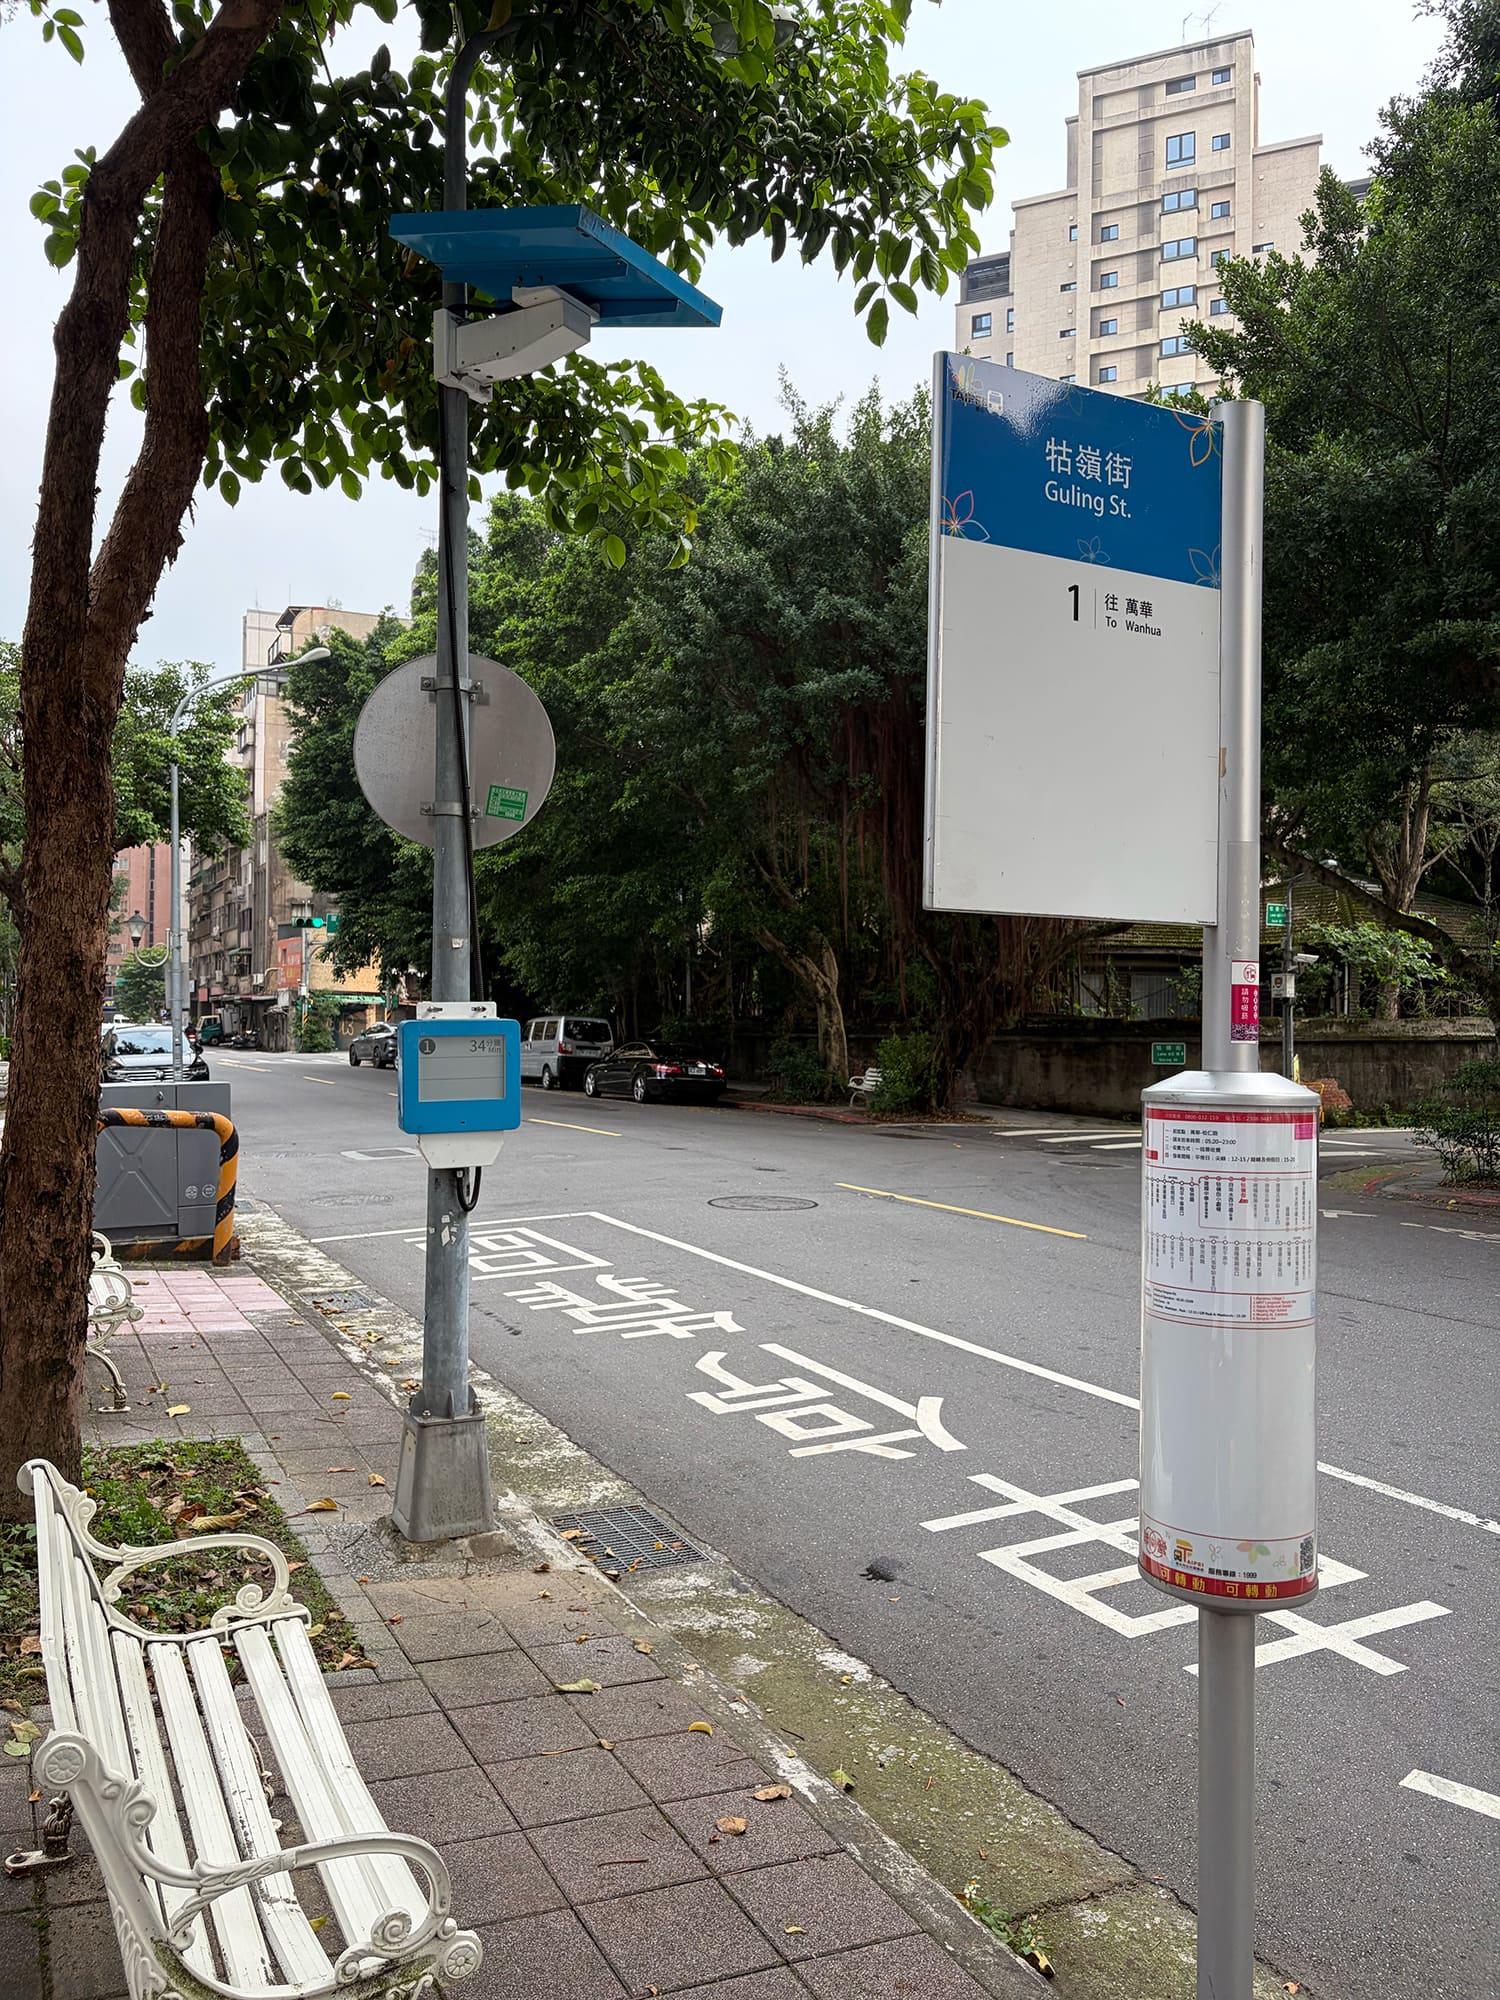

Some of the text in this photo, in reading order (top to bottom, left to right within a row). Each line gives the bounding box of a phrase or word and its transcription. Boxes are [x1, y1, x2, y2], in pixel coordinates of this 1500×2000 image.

[1045, 437, 1132, 489] 牯嶺街
[1044, 481, 1132, 519] Guling St.
[1067, 584, 1080, 622] 1
[1104, 592, 1153, 619] 往 萬華
[1105, 616, 1162, 637] To Wanhua
[469, 1040, 486, 1053] 34
[1225, 1582, 1278, 1598] 可轉動
